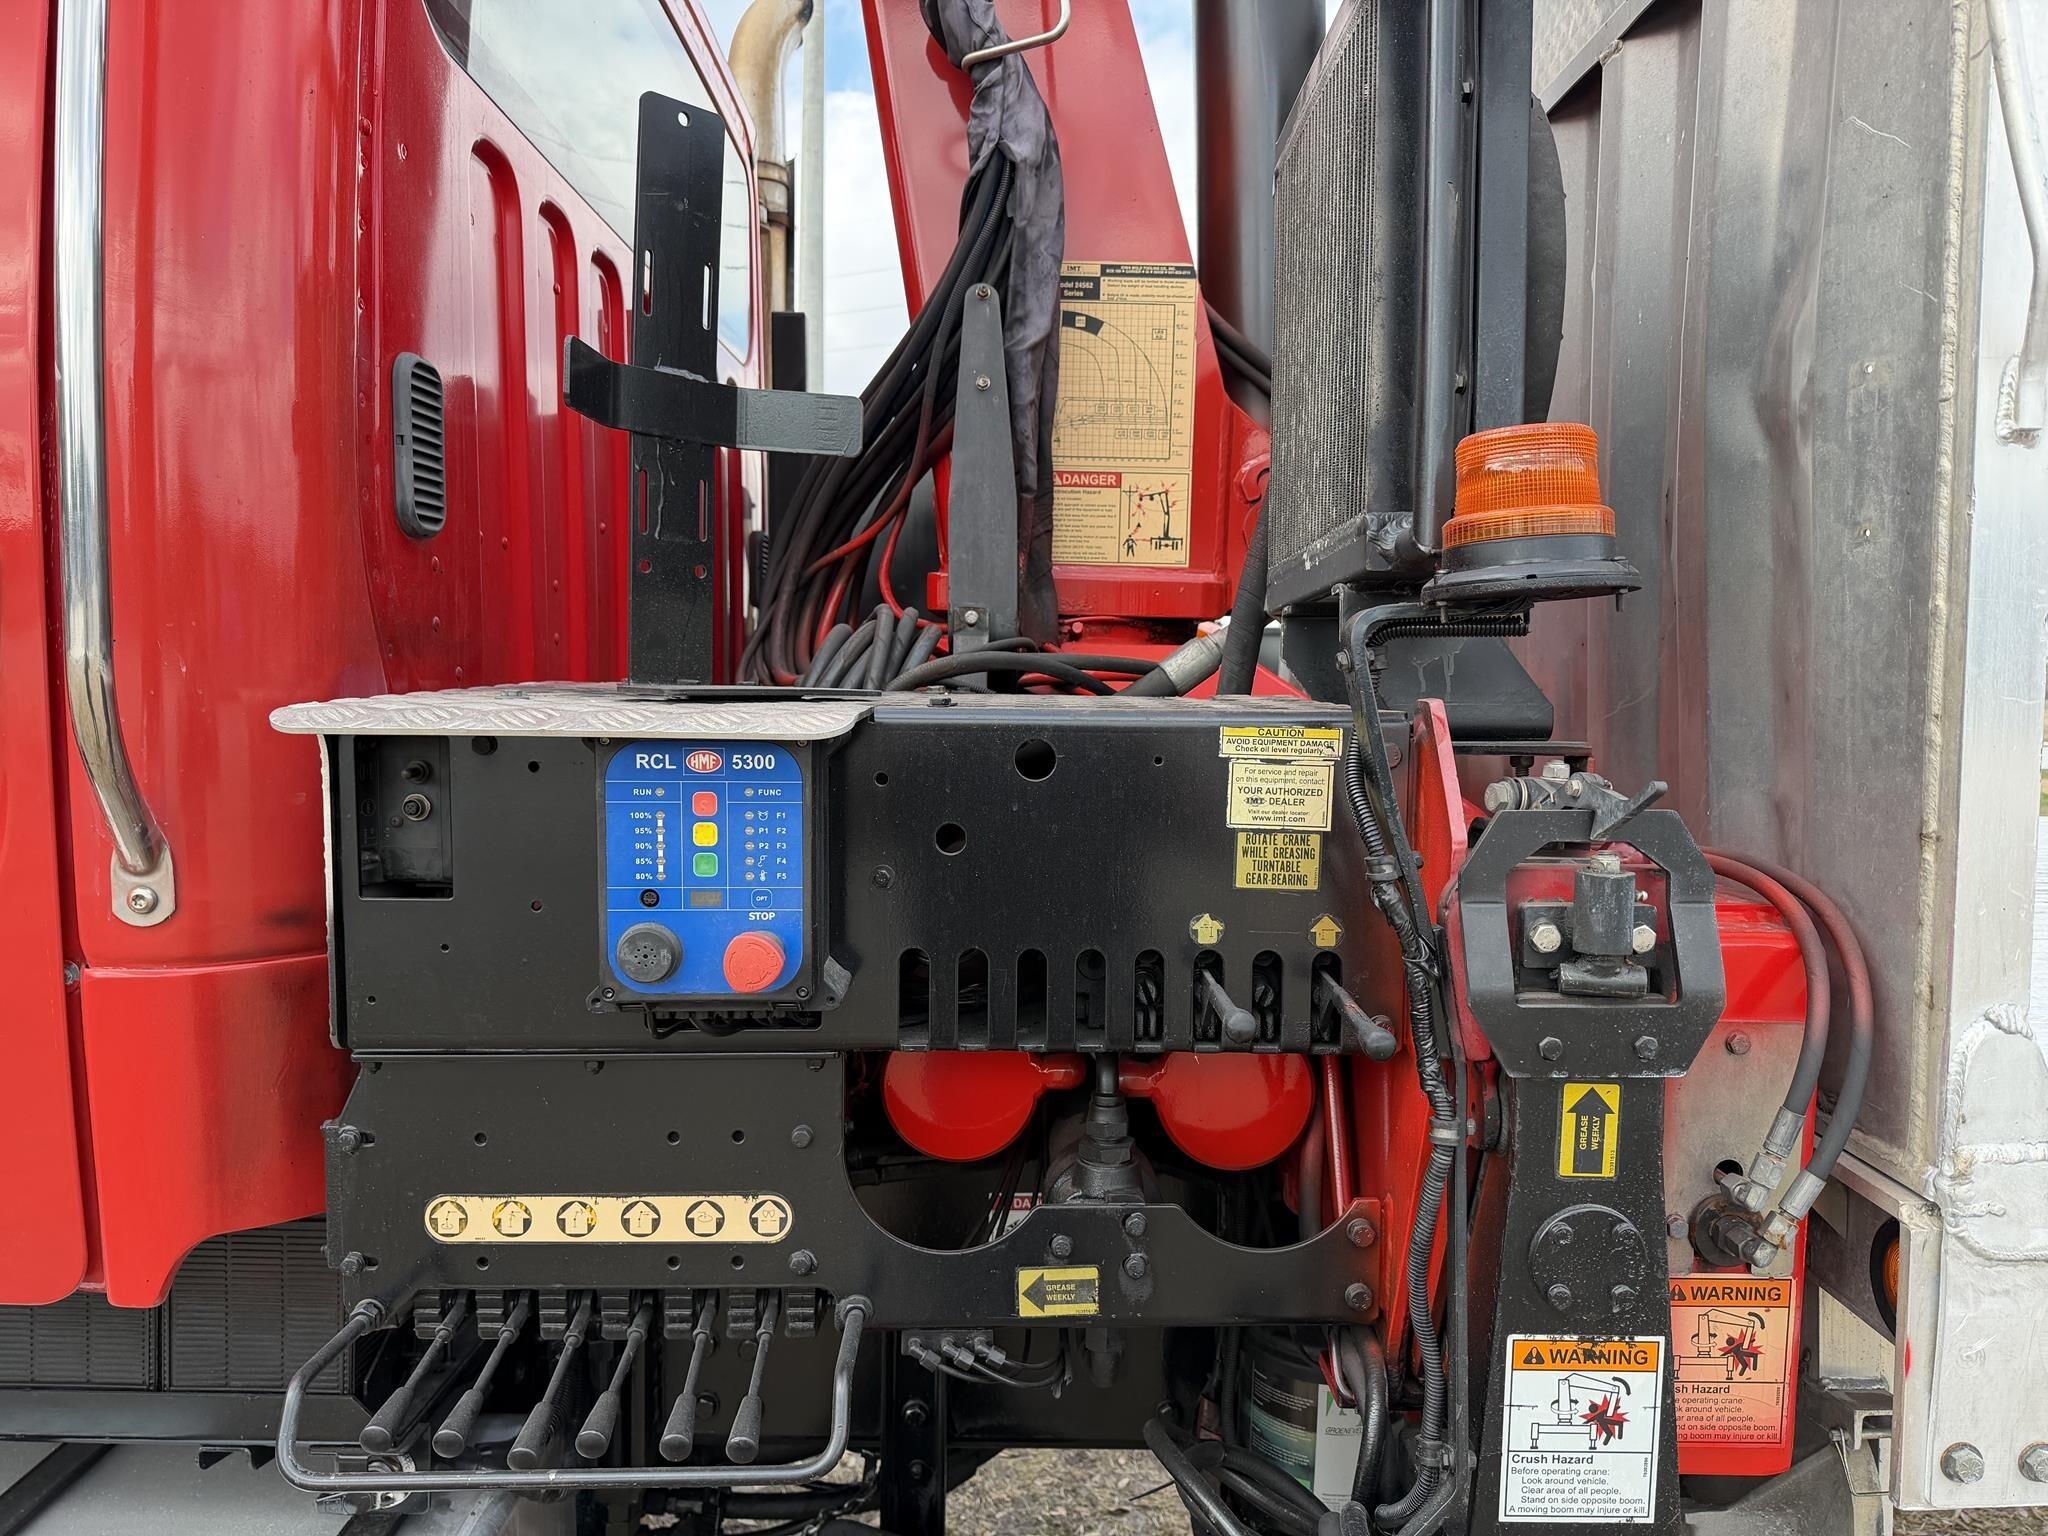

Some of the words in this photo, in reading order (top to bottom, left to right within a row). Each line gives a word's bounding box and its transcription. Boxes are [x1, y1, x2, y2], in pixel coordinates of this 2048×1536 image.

[1062, 474, 1116, 486] DANGER
[1257, 728, 1305, 737] CAUTION
[1300, 740, 1335, 748] DAMAGE
[1290, 747, 1325, 755] regularly.
[635, 753, 677, 769] RCL
[690, 754, 718, 767] HMF
[732, 754, 776, 770] 5300
[1238, 786, 1263, 794] YOUR
[1265, 787, 1323, 797] AUTHORIZED
[1269, 798, 1305, 806] DEALER
[1246, 834, 1277, 846] ROTATE
[1283, 834, 1311, 846] CRANE
[635, 842, 652, 850] 90%
[1242, 847, 1268, 858] WHILE
[1273, 848, 1316, 860] GREASING
[1252, 860, 1301, 872] TURNTABLE
[1246, 873, 1308, 886] GEAR-BEARING
[748, 912, 775, 921] STOP
[1580, 1115, 1588, 1150] GREASE
[1591, 1116, 1600, 1150] WEEKLY
[1046, 1293, 1076, 1301] WEEKLY
[1690, 1286, 1782, 1301] WARNING
[1549, 1349, 1648, 1366] WARNING
[1692, 1385, 1730, 1394] Hazard
[1682, 1397, 1719, 1405] operating
[1727, 1415, 1755, 1423] people.
[1718, 1424, 1751, 1432] opposite
[1733, 1433, 1754, 1441] injure
[1512, 1454, 1548, 1464] Crush
[1552, 1455, 1594, 1464] Hazard
[1511, 1467, 1539, 1475] Before
[1541, 1468, 1581, 1477] operating
[1521, 1486, 1544, 1494] Clear
[1590, 1487, 1622, 1496] people.
[1521, 1496, 1546, 1504] Stand
[1561, 1496, 1579, 1504] side
[1581, 1497, 1617, 1506] opposite
[1619, 1497, 1646, 1505] boom.
[1517, 1506, 1548, 1514] moving
[1576, 1507, 1595, 1515] may
[1597, 1506, 1620, 1515] injure
[1634, 1506, 1647, 1514] kill.
